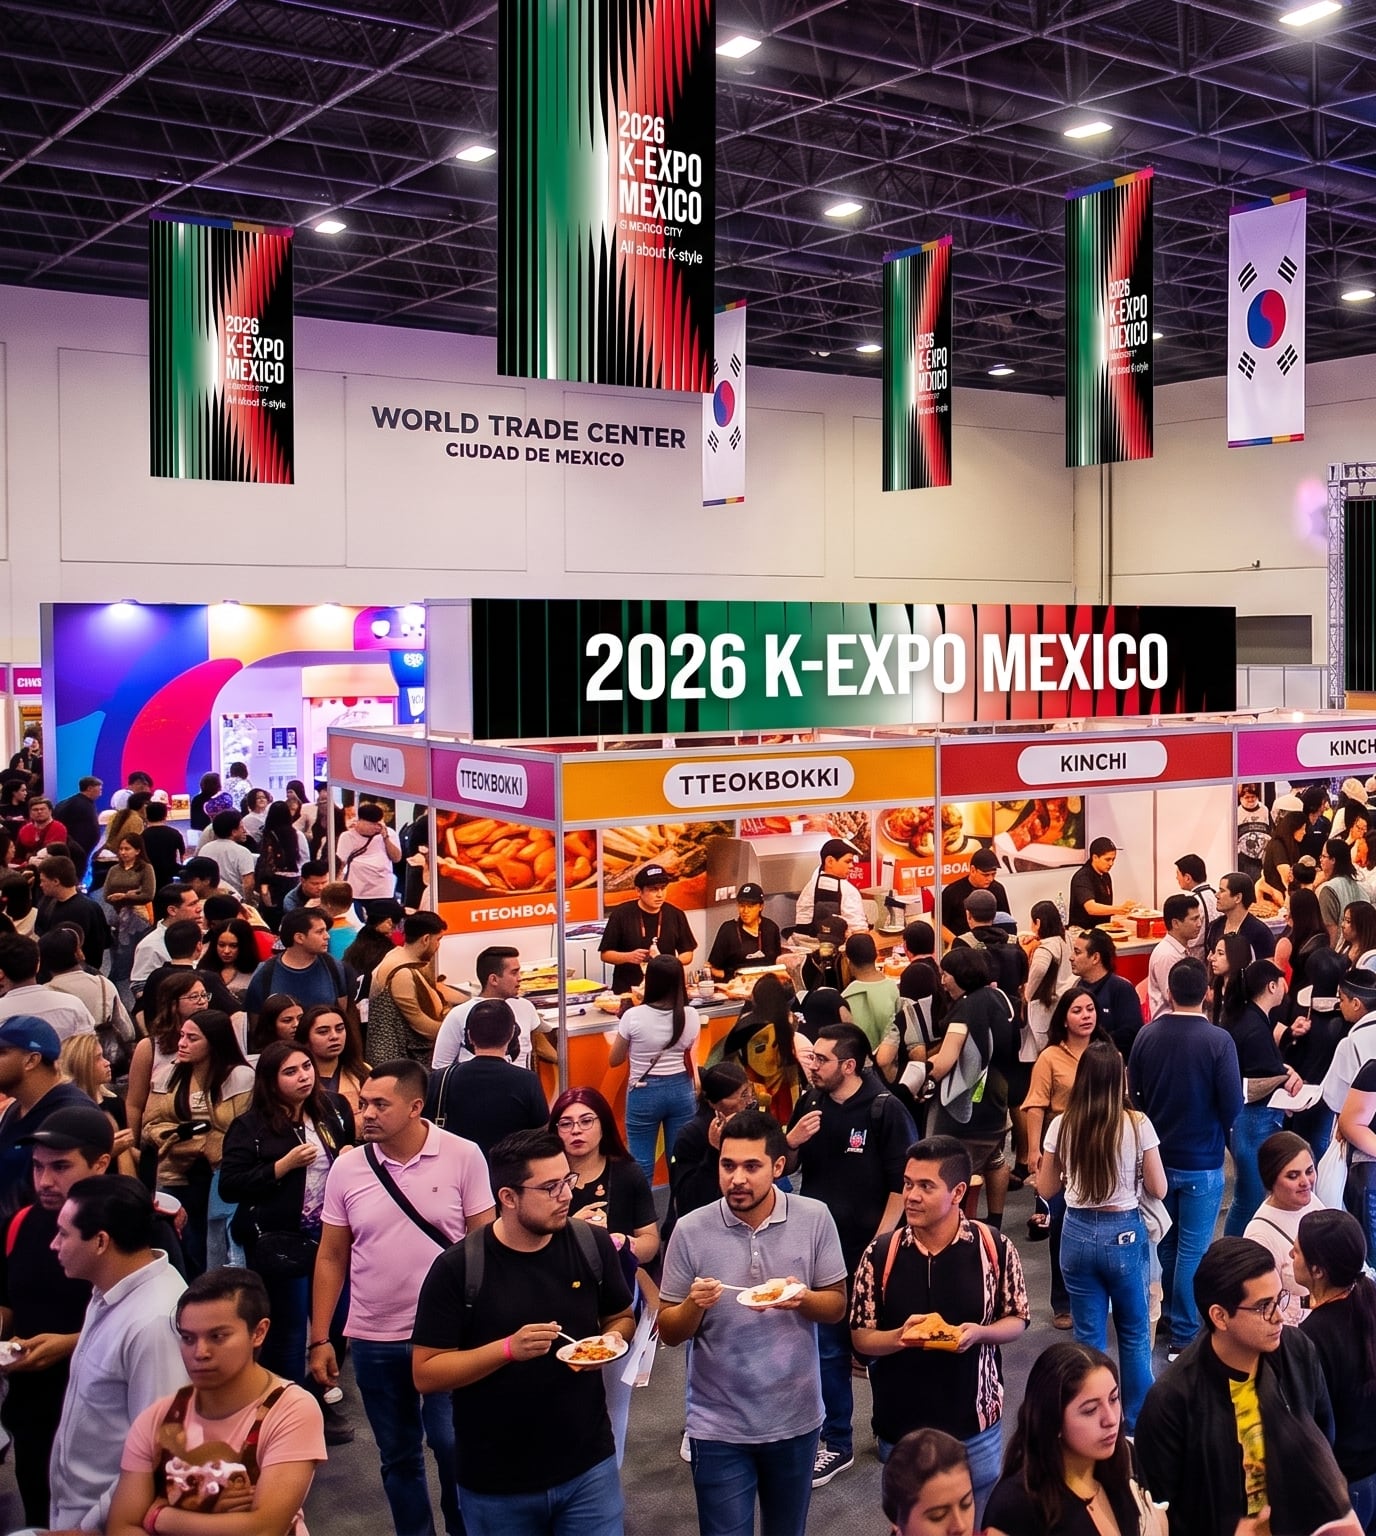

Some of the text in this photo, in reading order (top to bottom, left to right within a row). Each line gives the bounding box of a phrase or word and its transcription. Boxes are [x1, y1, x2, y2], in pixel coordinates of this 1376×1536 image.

[618, 110, 665, 144] 2026
[619, 140, 702, 188] K-EXPO
[619, 179, 702, 225] MEXICO
[620, 239, 703, 266] All about K-style
[1109, 278, 1131, 300] 2026
[1109, 294, 1148, 326] K-EXPO
[225, 315, 260, 335] 2026
[1109, 320, 1148, 350] MEXICO
[226, 334, 285, 361] K-EXPO
[225, 357, 285, 384] MEXICO
[371, 405, 687, 449] WORLD TRADE CENTER
[445, 442, 625, 467] CIUDAD DE MEXICO
[585, 632, 1169, 702] 2026 K-EXPO MEXICO
[363, 754, 390, 774] KINCHI
[1060, 752, 1127, 774] KINCHI
[460, 769, 523, 796] TTEOKBOKKI
[679, 767, 840, 796] TTEOKBOKKI
